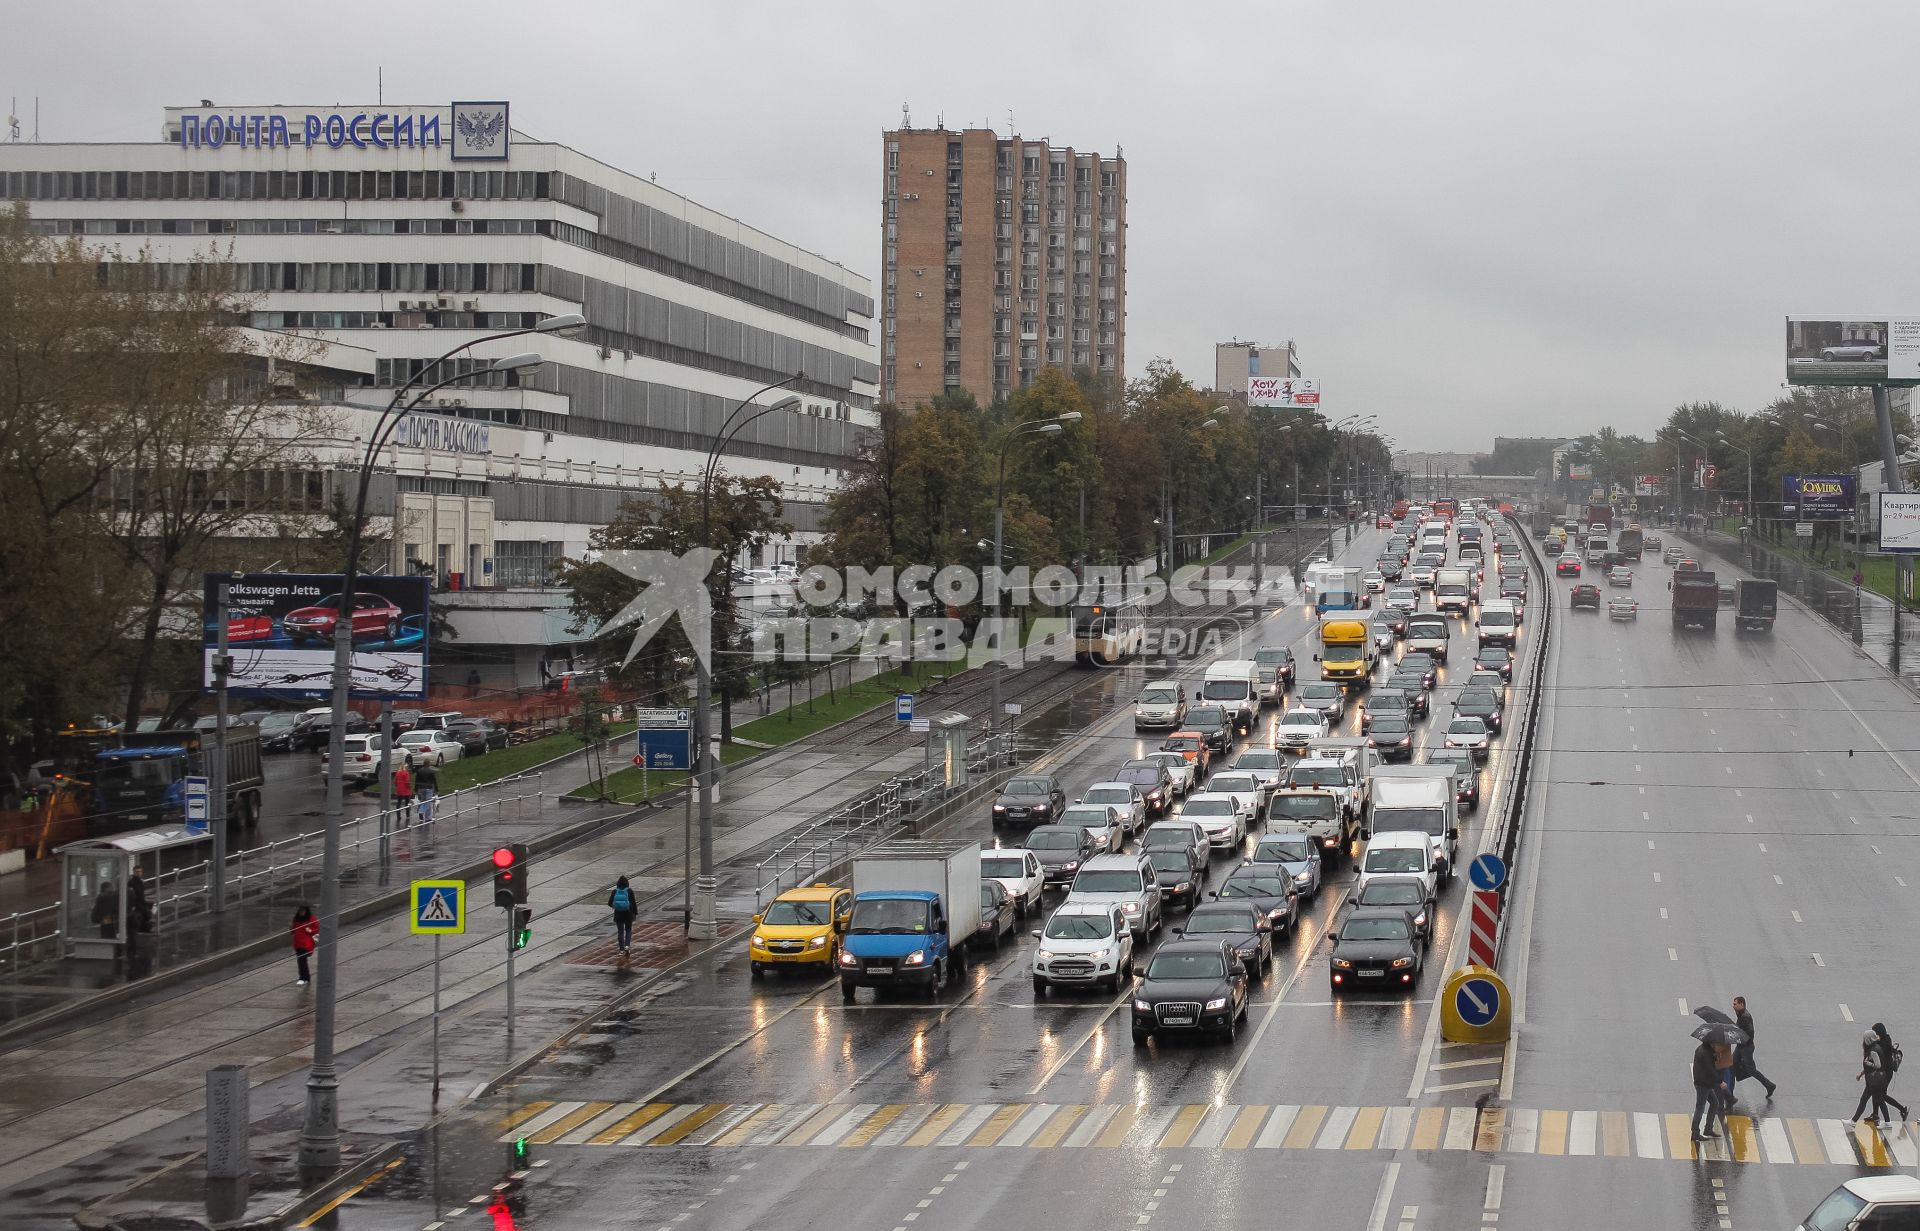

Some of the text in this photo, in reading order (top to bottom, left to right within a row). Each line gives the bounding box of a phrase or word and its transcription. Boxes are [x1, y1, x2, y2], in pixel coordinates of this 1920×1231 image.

[181, 114, 441, 149] ПОЧТА РОССИИ
[409, 416, 479, 454] ПОЧТА РОССИИ
[1892, 512, 1903, 520] 29
[229, 584, 320, 598] olkswagen Jetta
